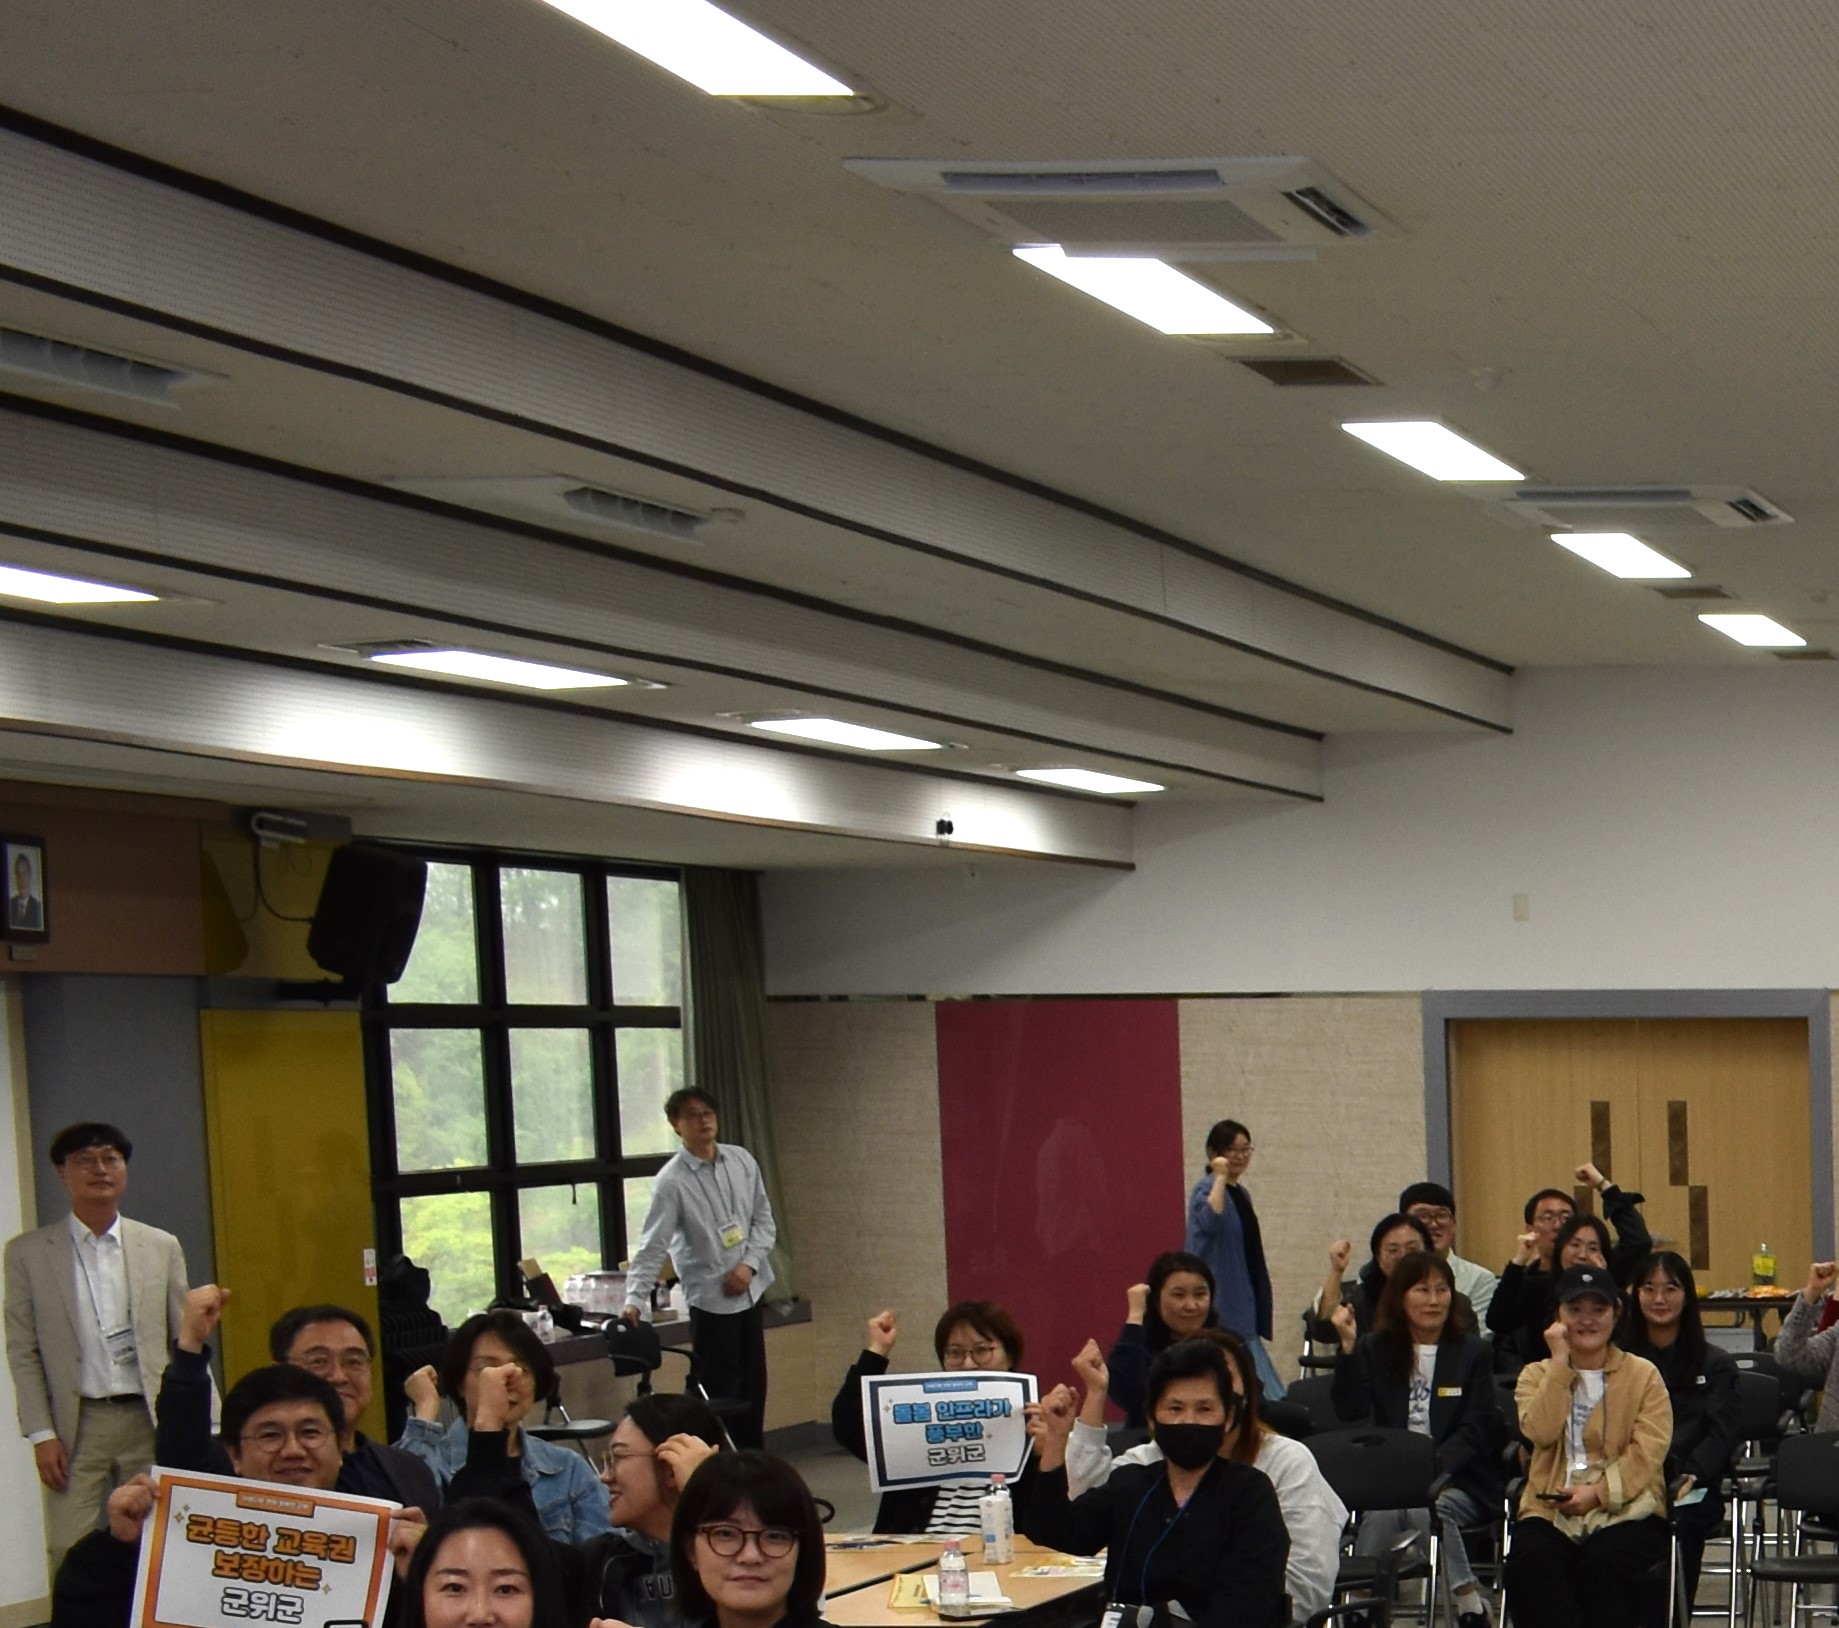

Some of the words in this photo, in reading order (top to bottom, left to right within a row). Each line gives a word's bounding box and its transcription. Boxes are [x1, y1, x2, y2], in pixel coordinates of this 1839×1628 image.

[935, 1398, 1012, 1421] 인프라가
[926, 1421, 984, 1444] 풍부한
[928, 1443, 986, 1467] 군위군
[186, 1514, 270, 1551] 균등한
[273, 1526, 357, 1564] 교육권
[212, 1550, 322, 1591] 보장하는
[221, 1586, 304, 1625] 군위군
